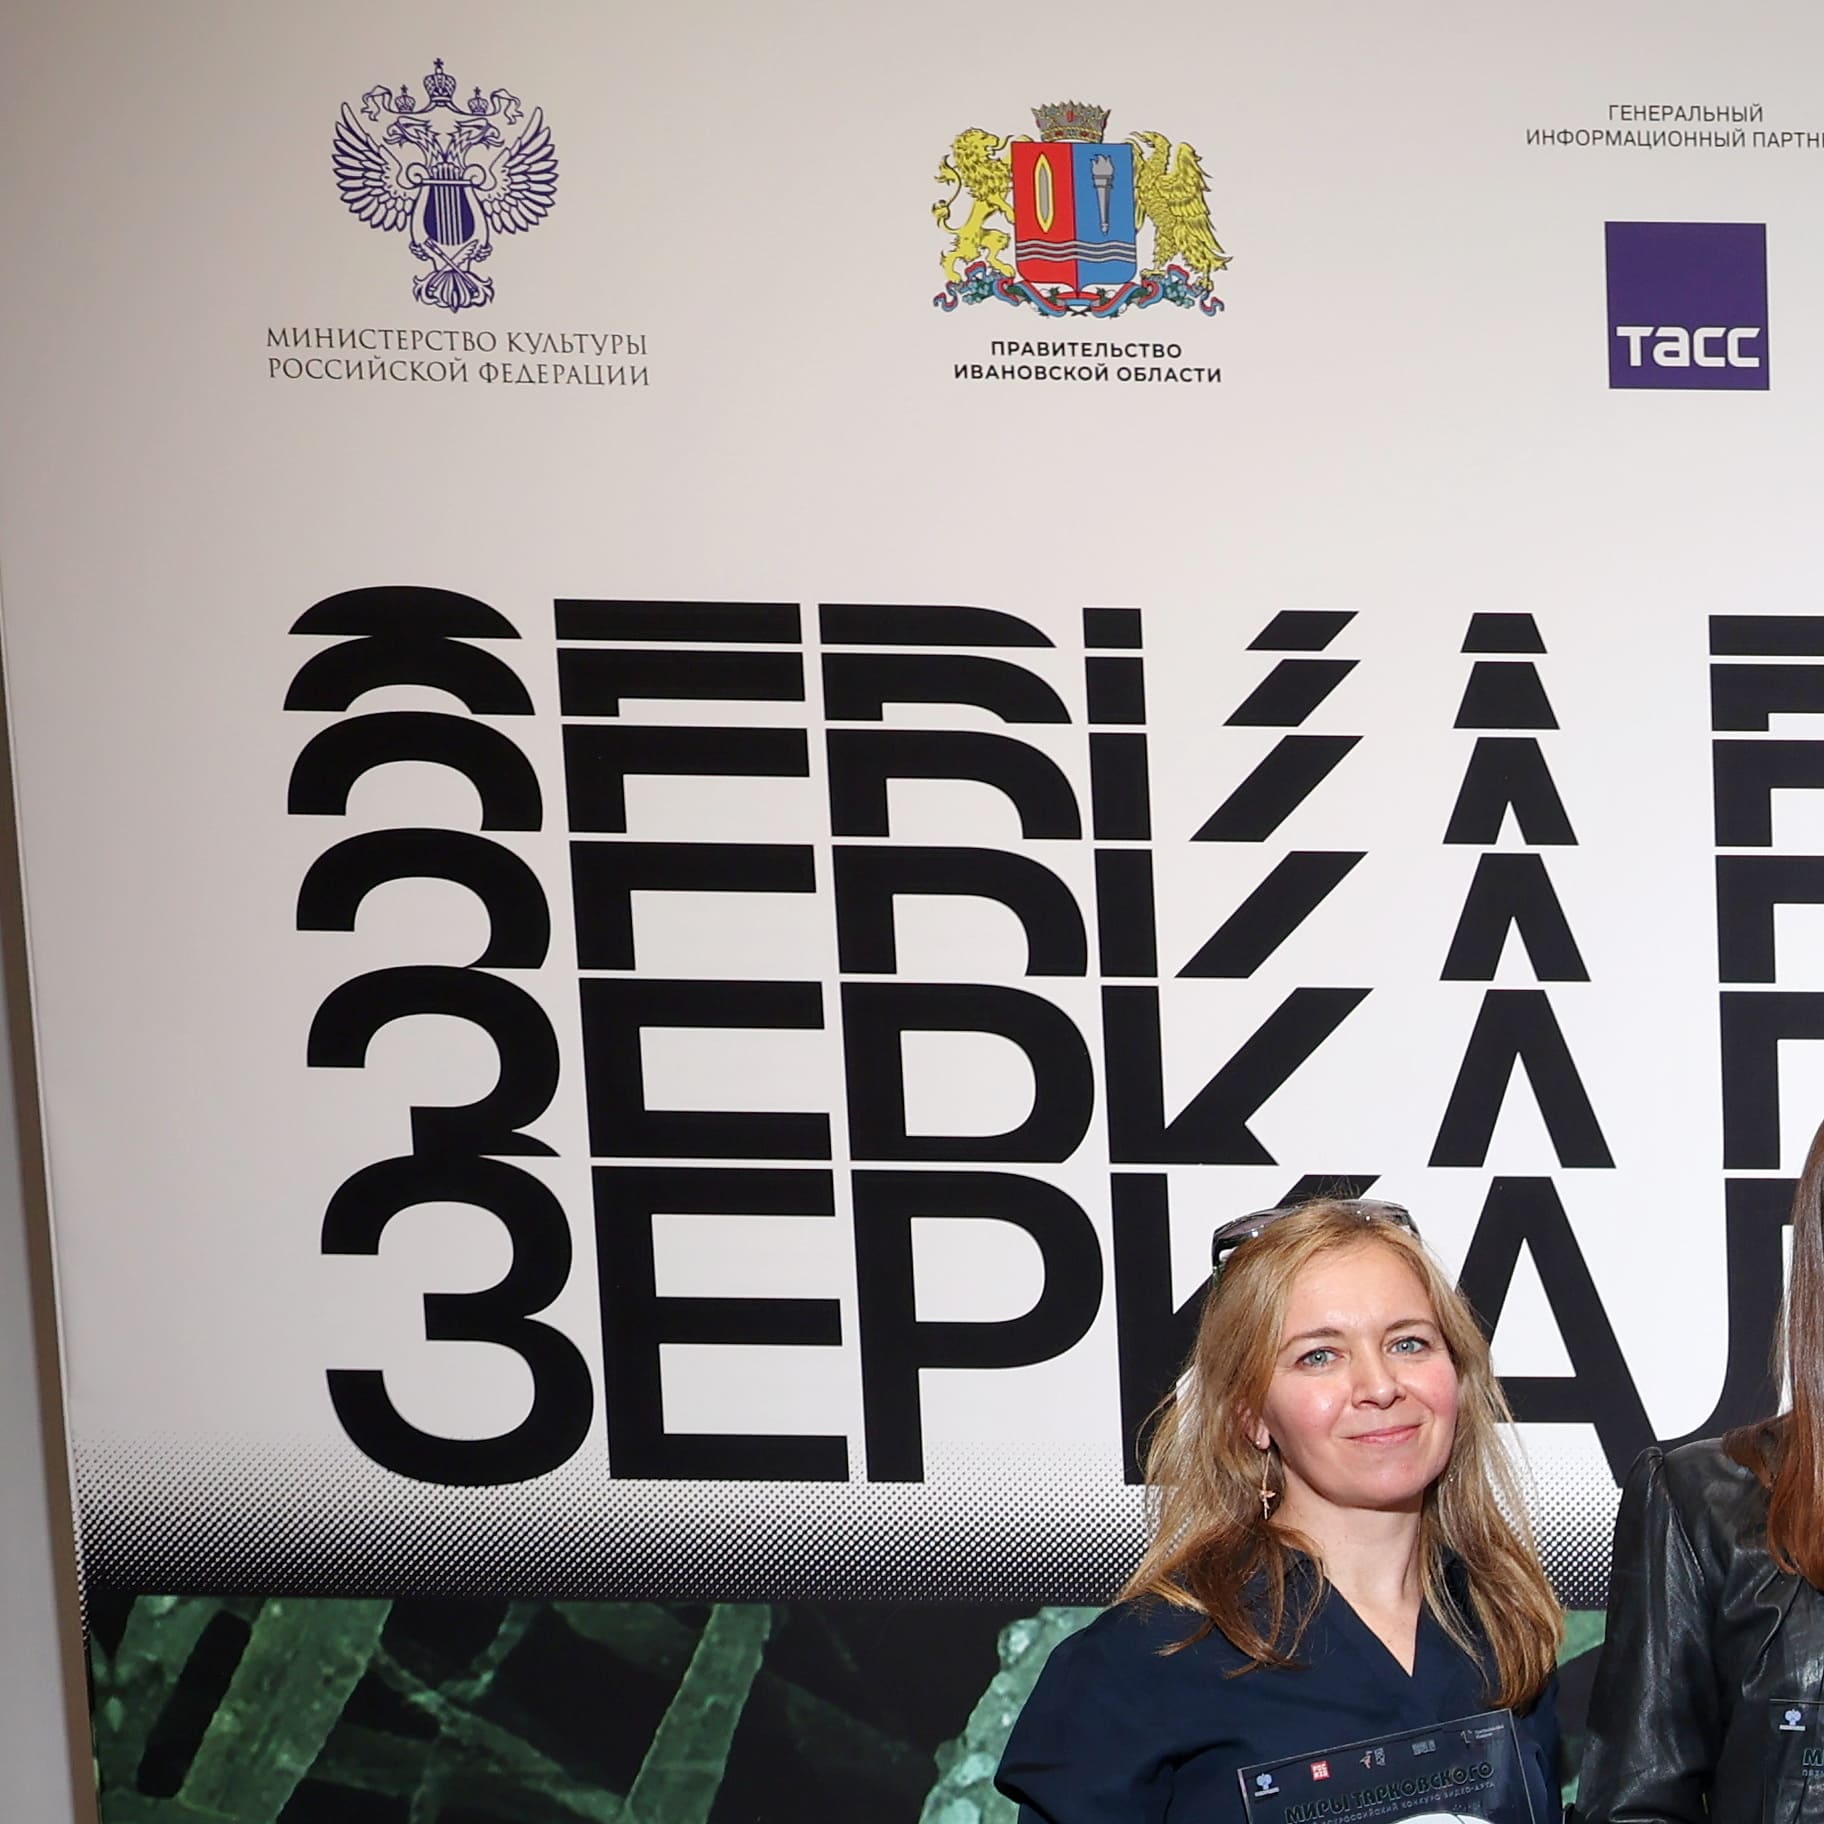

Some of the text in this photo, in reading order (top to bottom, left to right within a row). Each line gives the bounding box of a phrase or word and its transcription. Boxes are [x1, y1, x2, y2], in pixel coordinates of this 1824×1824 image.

[1607, 101, 1764, 124] ГЕНЕРАЛЬНЫЙ
[1525, 125, 1746, 150] ИНФОРМАЦИОННЫЙ
[266, 326, 649, 356] МИНИСТЕРСТВО КУЛЬТУРЫ
[990, 341, 1182, 358] ПРАВИТЕЛЬСТВО
[267, 352, 650, 387] РОССИЙСКОЙ ФЕДЕРАЦИИ
[954, 362, 1222, 383] ИВАНОВСКОЙ ОБЛАСТИ
[1352, 1761, 1495, 1810] ТАРКОВСКОГО
